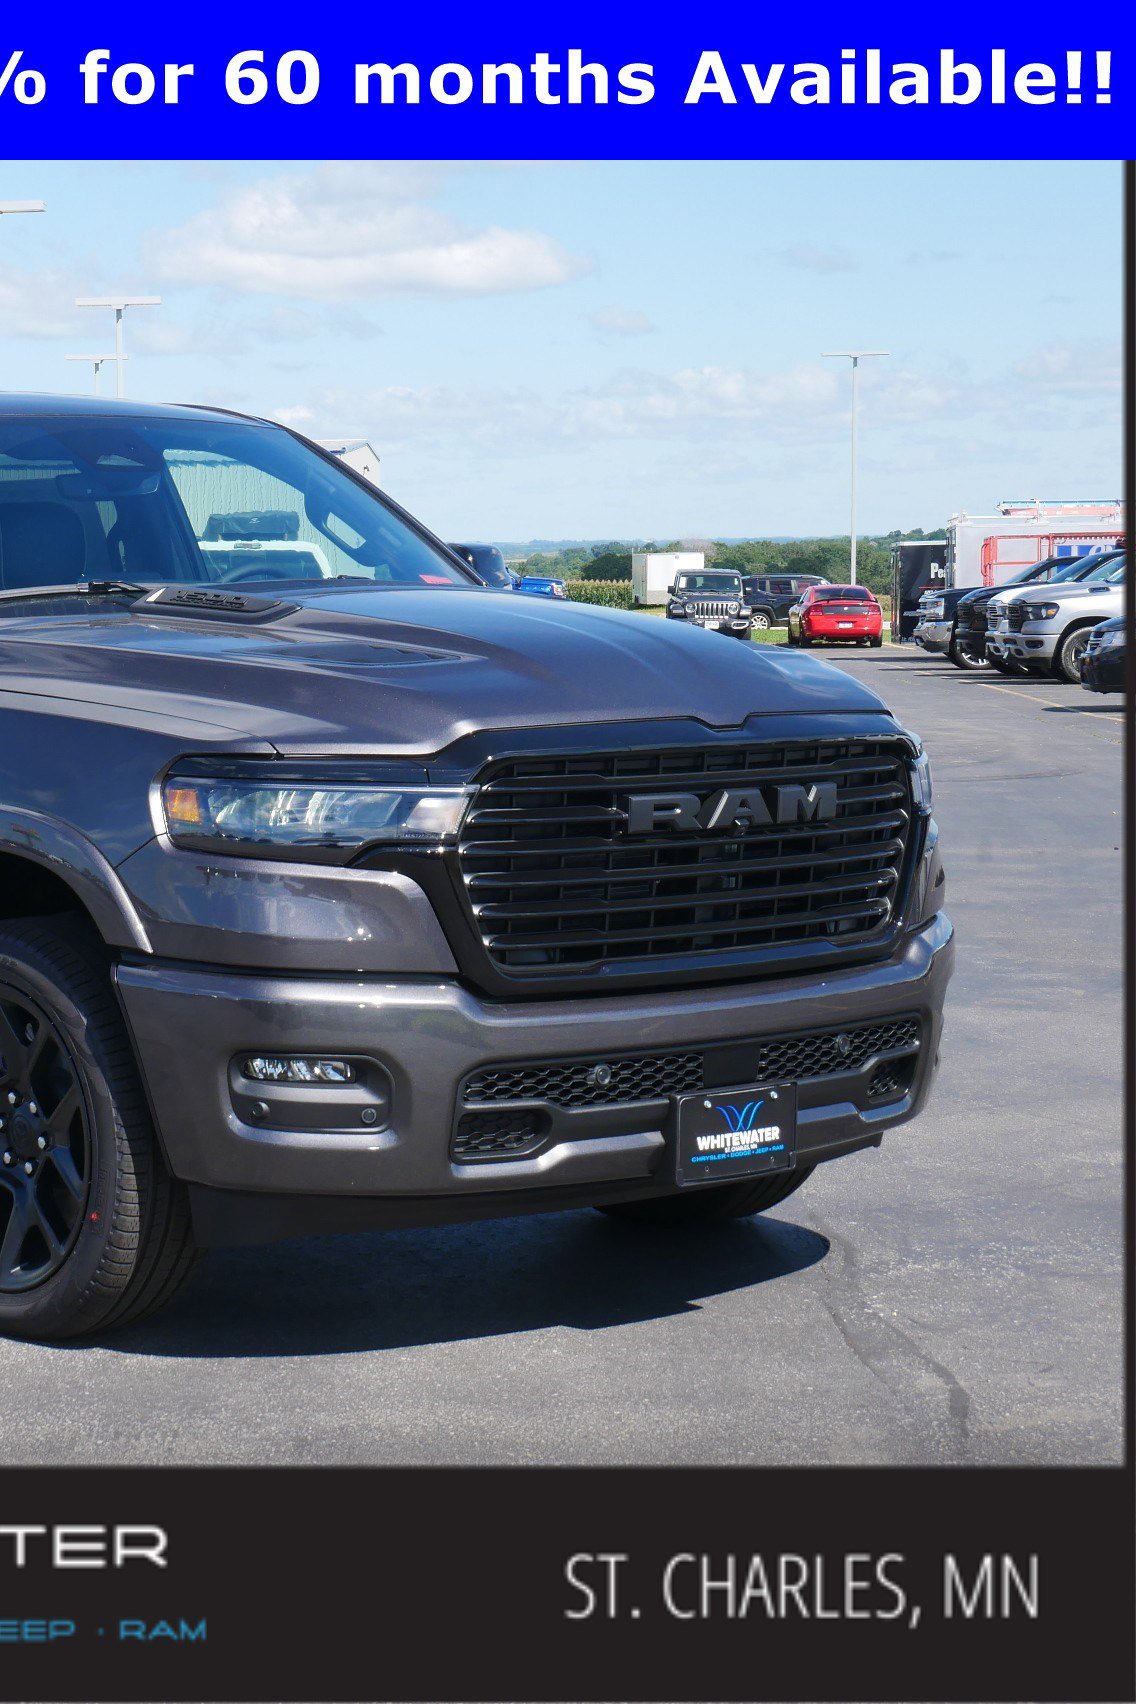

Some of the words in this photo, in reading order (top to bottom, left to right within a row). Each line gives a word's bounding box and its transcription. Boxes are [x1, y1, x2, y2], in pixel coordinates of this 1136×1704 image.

[626, 781, 838, 836] RAM
[696, 1125, 781, 1151] WHITEWATER
[691, 1152, 727, 1163] CHRYSLER
[730, 1149, 752, 1158] DODGE
[755, 1146, 769, 1155] JEEP
[772, 1144, 785, 1152] RAM
